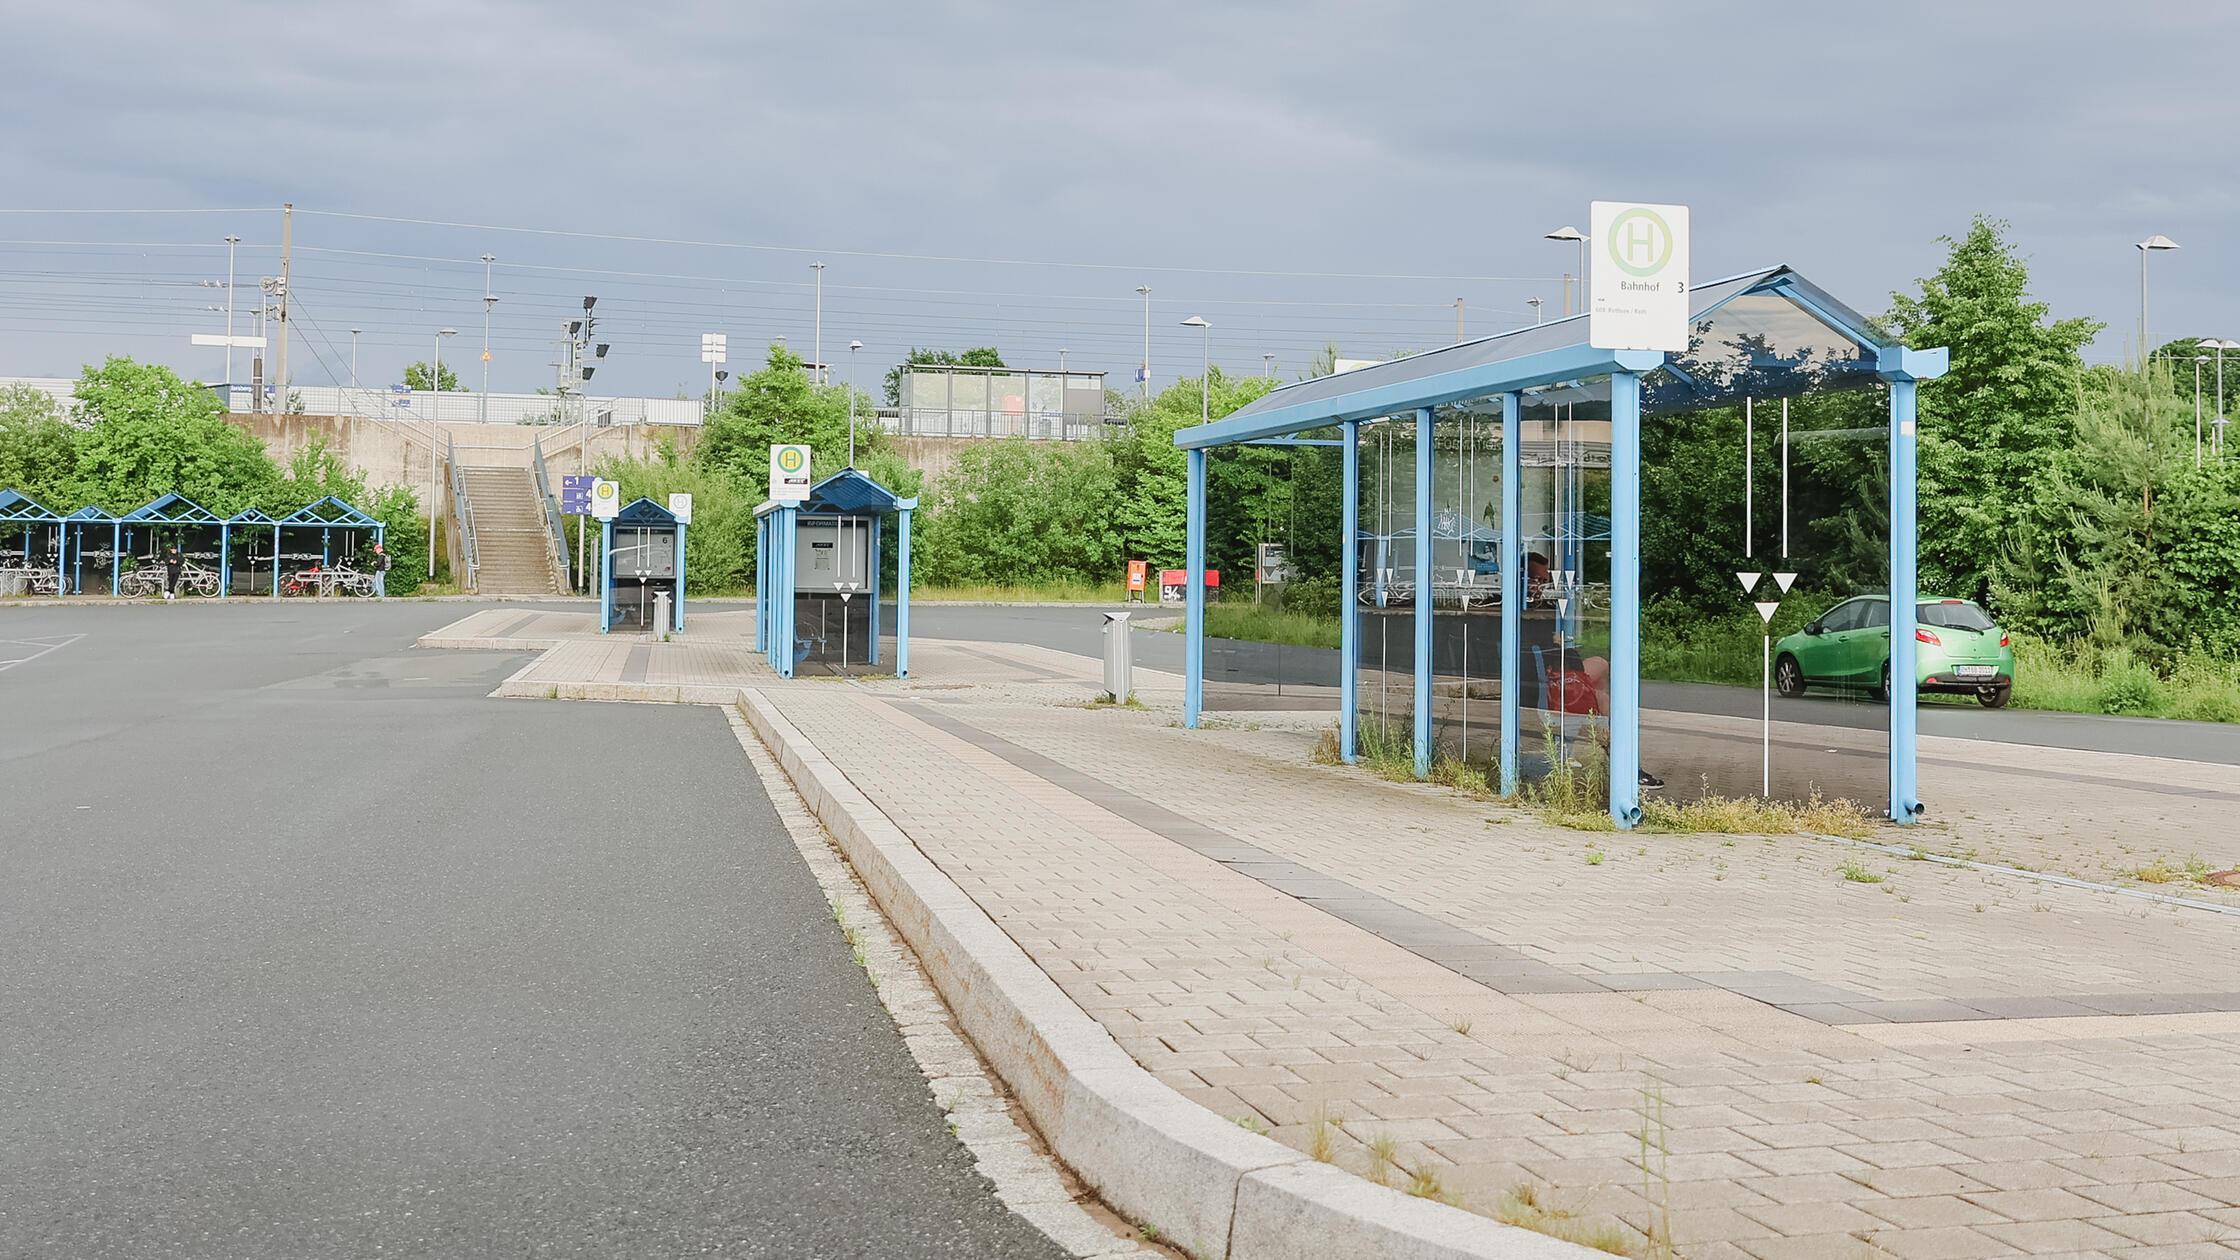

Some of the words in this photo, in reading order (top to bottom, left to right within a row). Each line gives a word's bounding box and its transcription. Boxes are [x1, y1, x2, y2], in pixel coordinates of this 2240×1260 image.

[1627, 222, 1654, 262] H
[1620, 280, 1661, 292] Bahnhof
[1677, 282, 1685, 293] 3
[574, 476, 580, 486] 1
[585, 489, 592, 499] 4
[585, 502, 592, 512] 4
